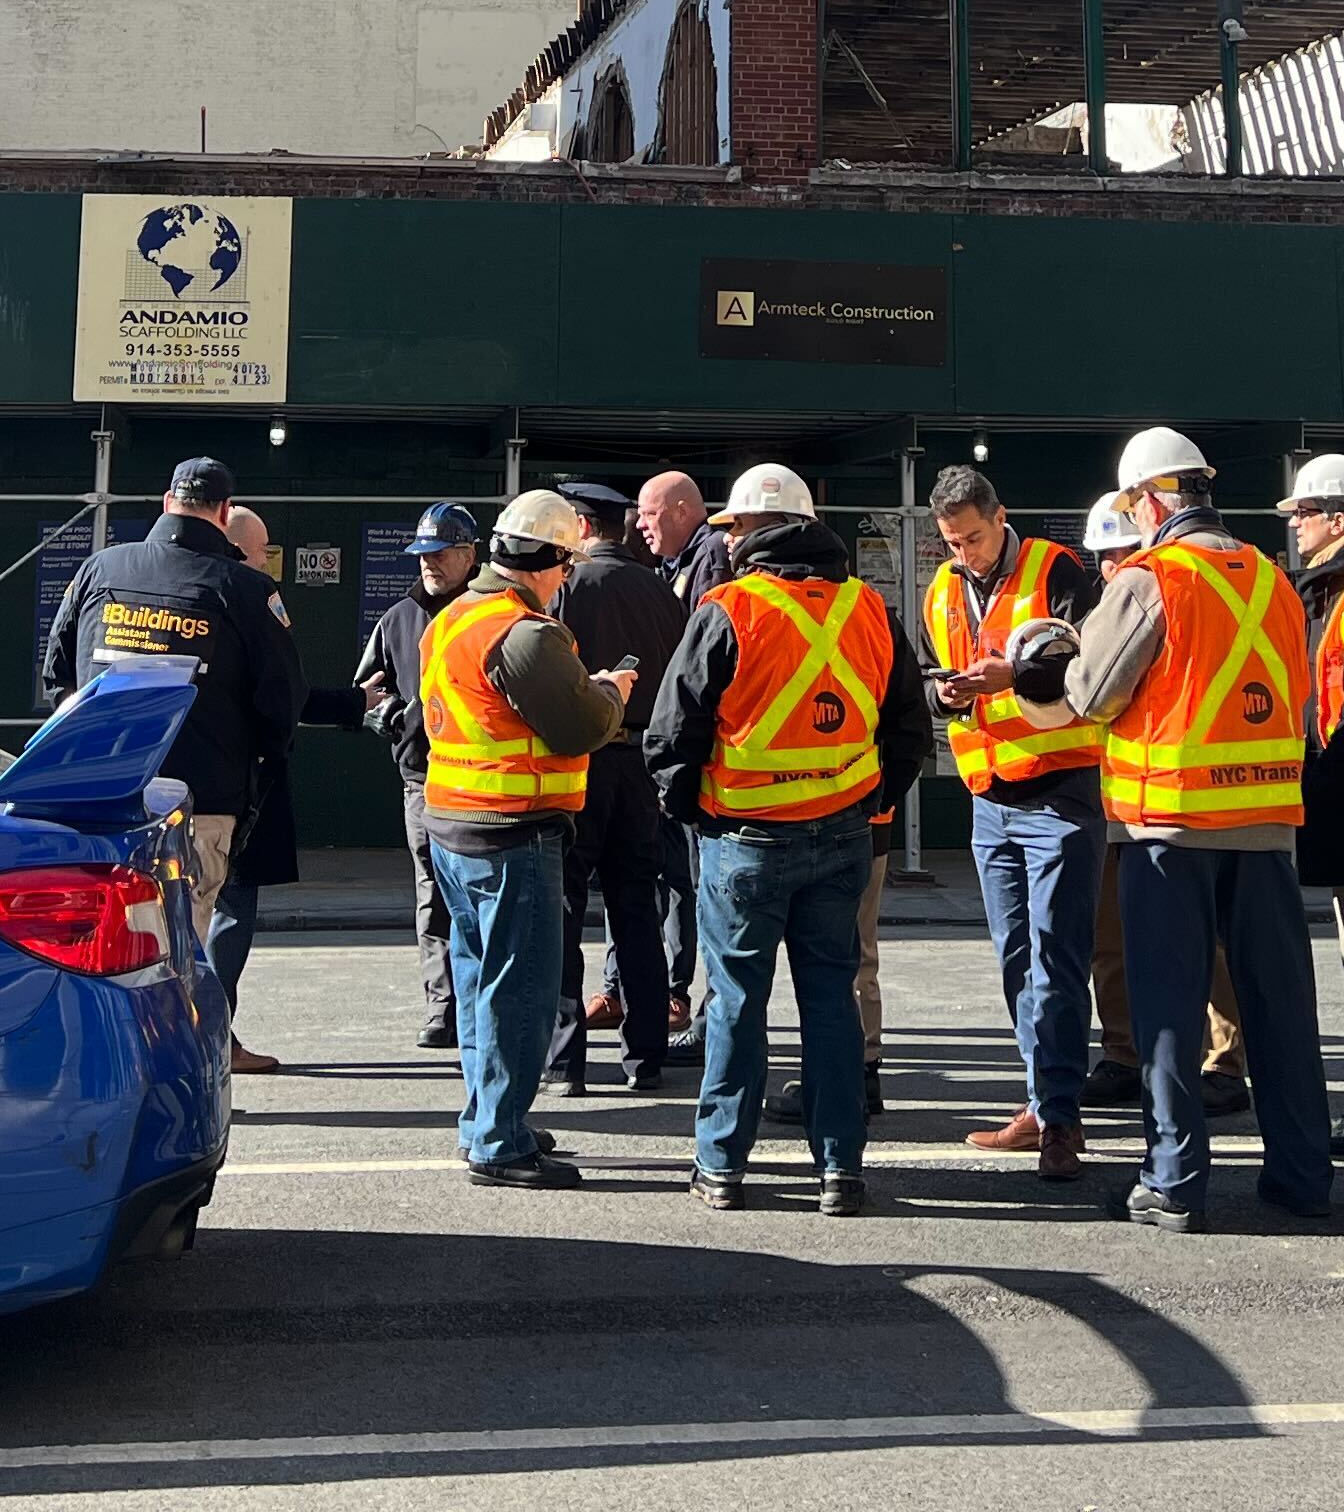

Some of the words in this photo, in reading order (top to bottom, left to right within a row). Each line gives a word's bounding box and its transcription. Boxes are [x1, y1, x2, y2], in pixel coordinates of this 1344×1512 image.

[723, 296, 748, 321] A
[757, 300, 826, 317] Armteck
[830, 302, 935, 321] Construction
[119, 310, 249, 325] ANDAMIO
[119, 326, 220, 339] SCAFFOLDING
[223, 327, 249, 339] LLC
[125, 343, 241, 357] 914-353-5555
[299, 554, 318, 569] NO
[298, 570, 337, 579] SMOKING
[109, 603, 209, 639] Buildings
[105, 625, 151, 639] Assistant
[104, 635, 169, 652] Commissioner
[1242, 692, 1269, 716] MTA
[812, 701, 840, 726] MTA
[1209, 766, 1247, 785] NYC
[1250, 765, 1299, 782] Trans
